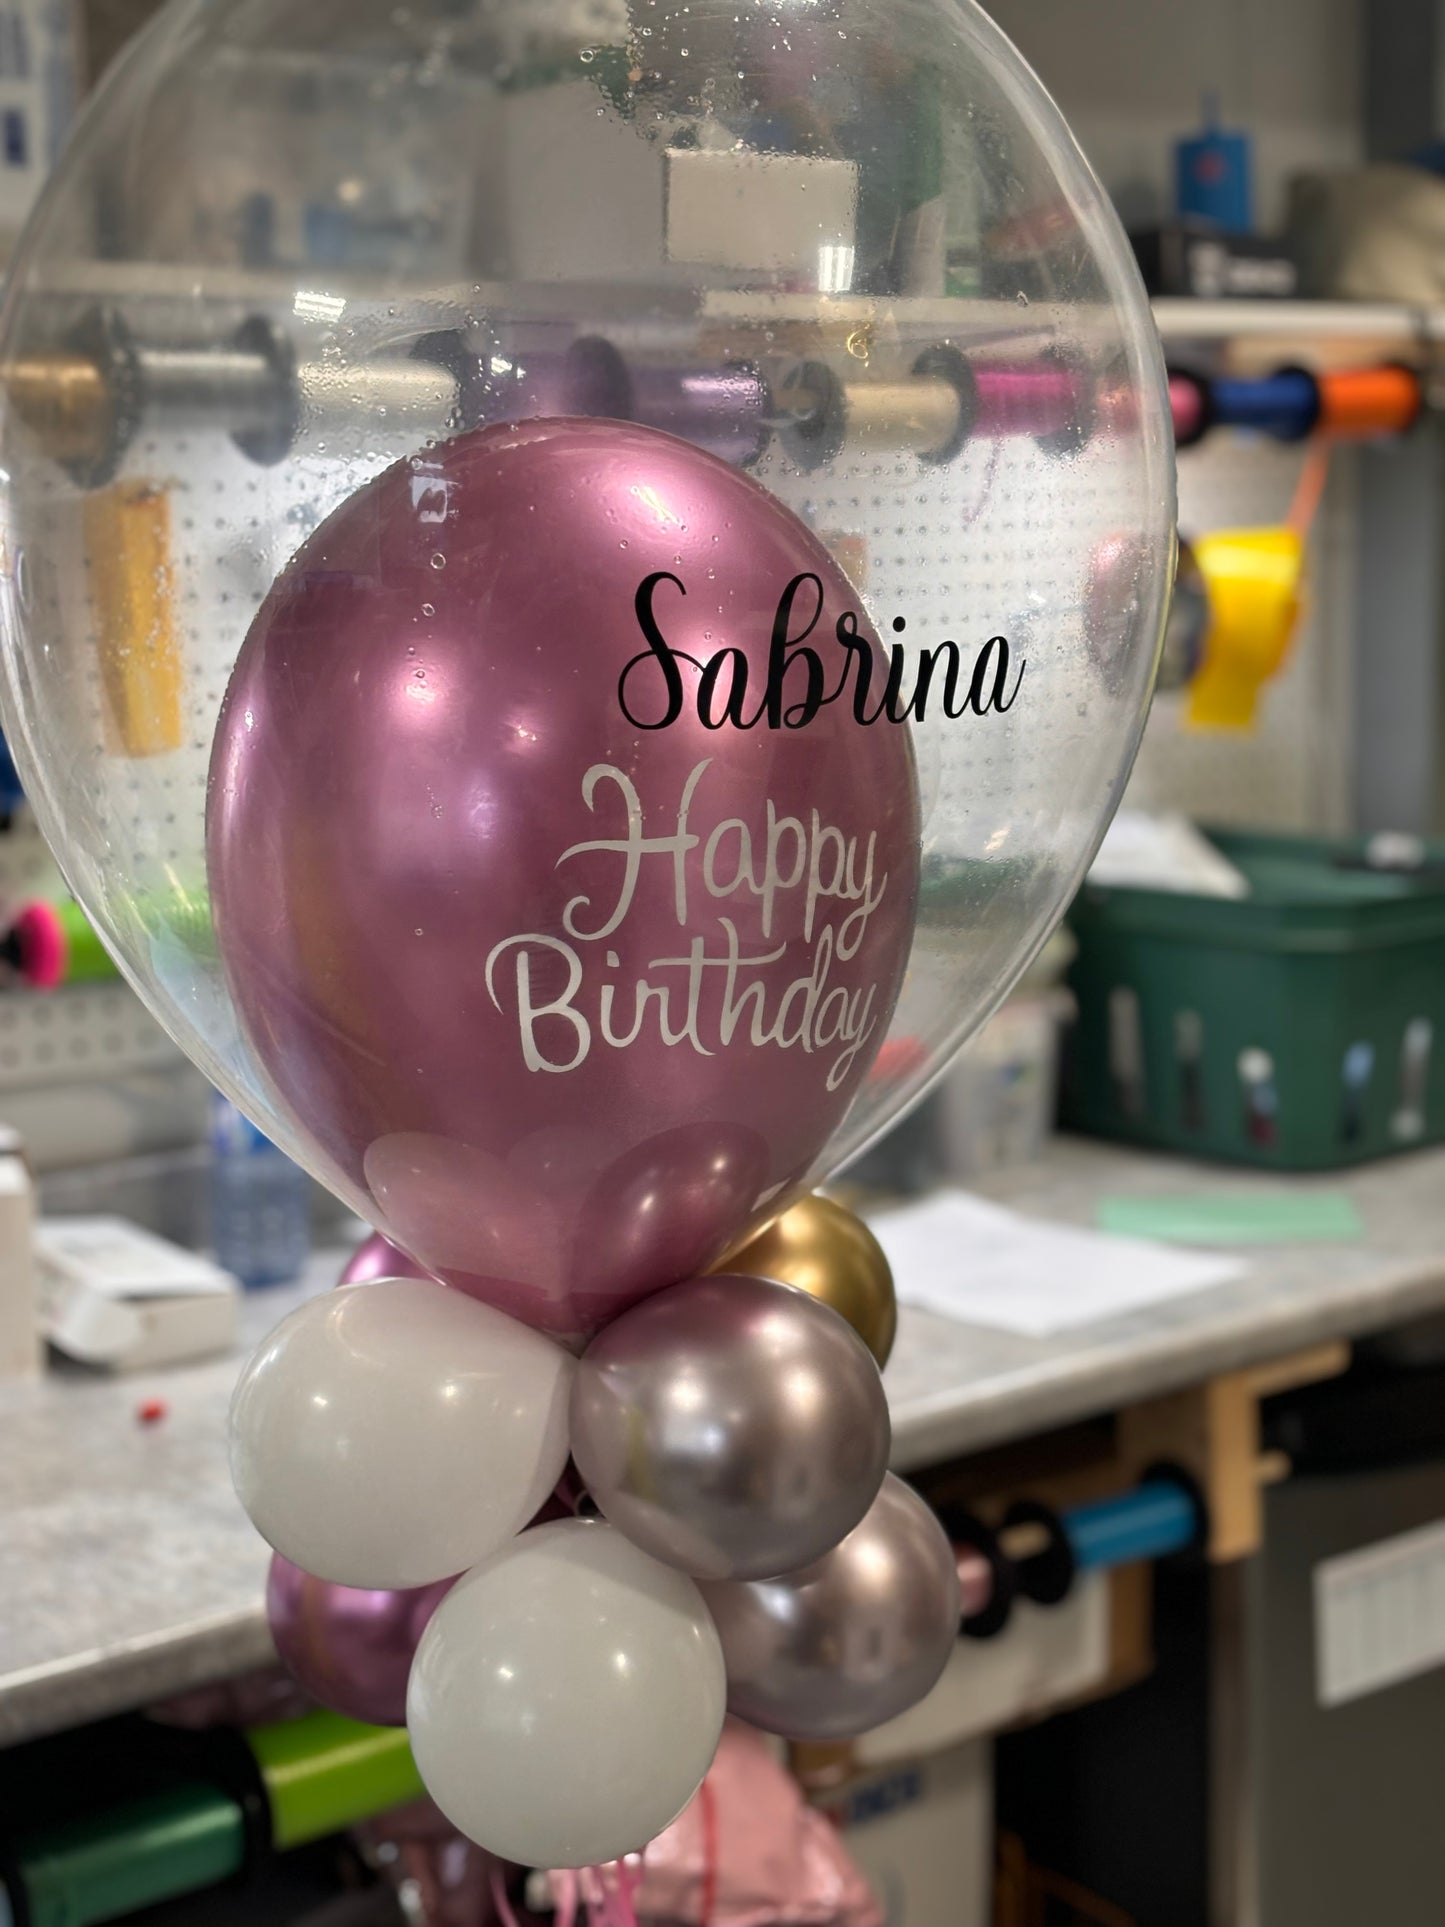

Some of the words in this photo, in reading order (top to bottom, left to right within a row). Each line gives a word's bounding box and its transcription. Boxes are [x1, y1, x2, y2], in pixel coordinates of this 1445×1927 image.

[617, 571, 1027, 730] Sabrina
[554, 757, 888, 961] Happy
[485, 917, 877, 1092] Birthday
